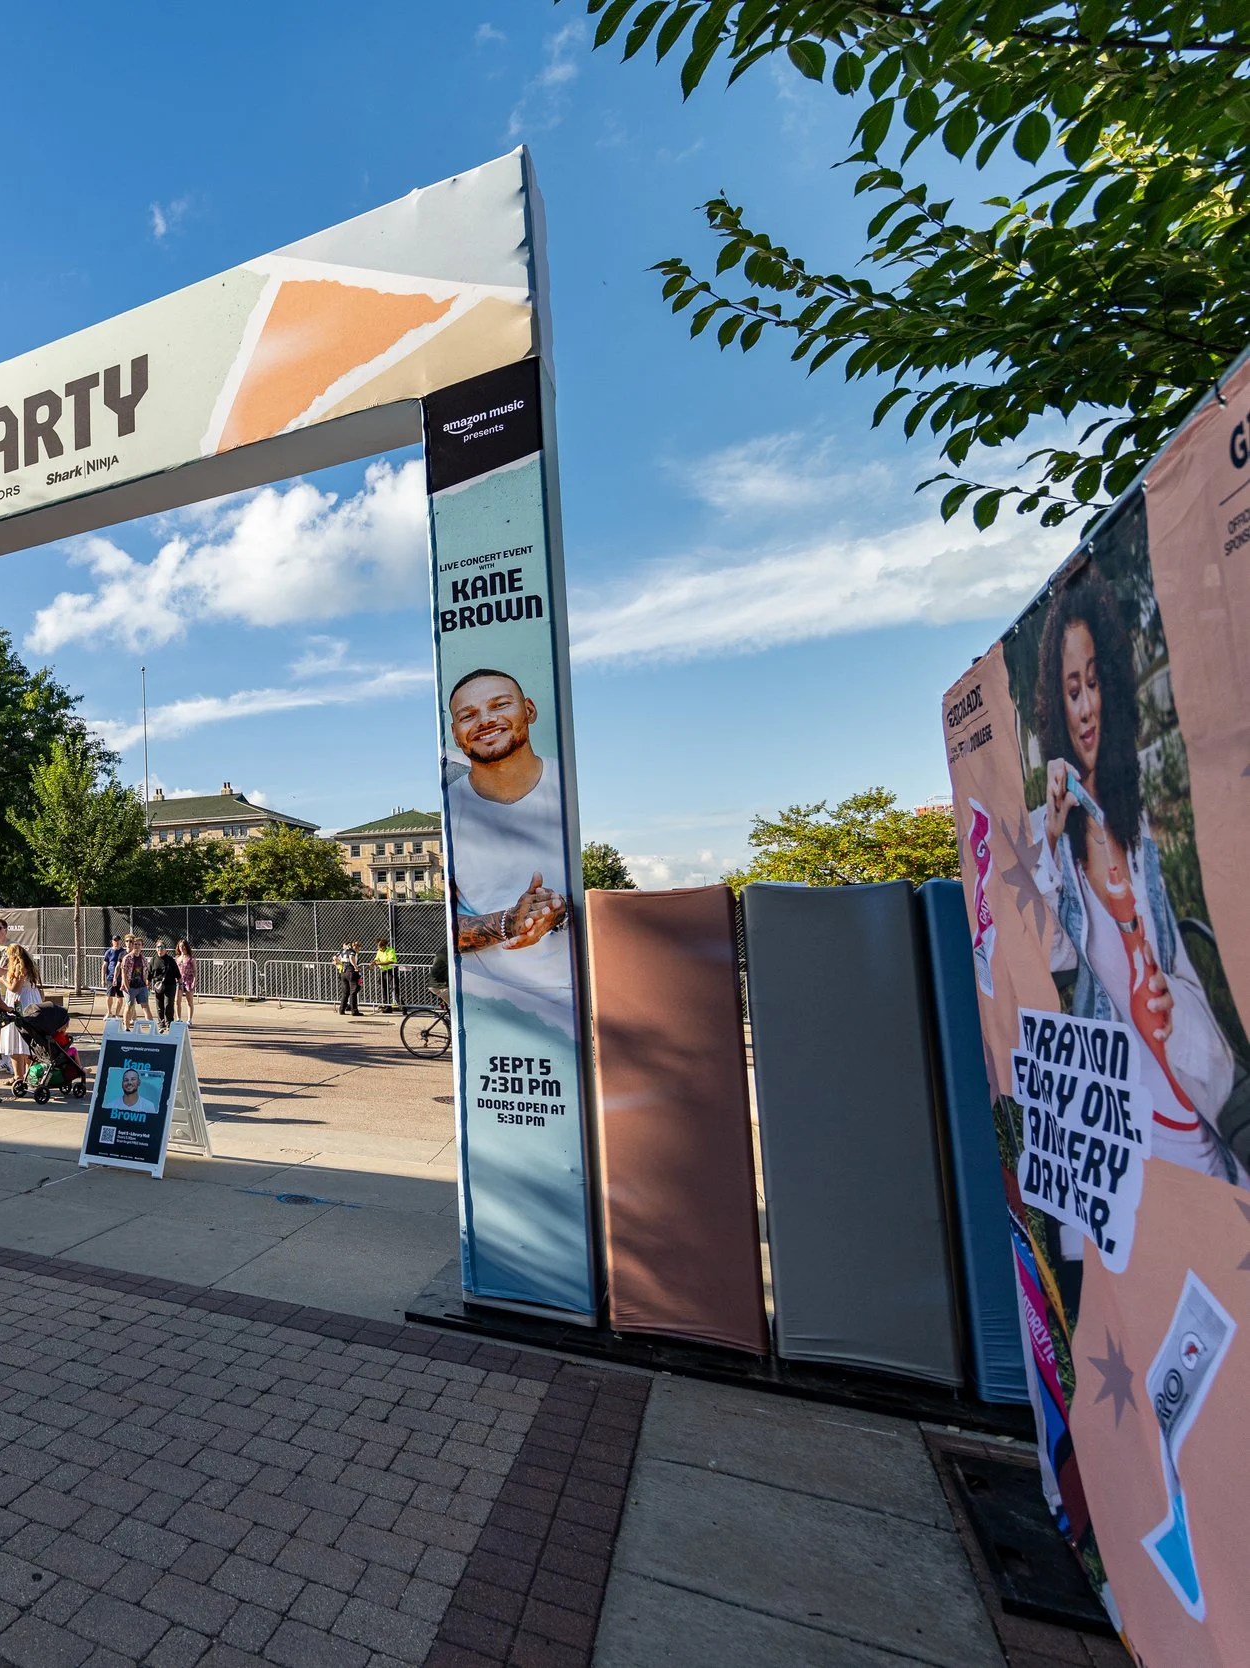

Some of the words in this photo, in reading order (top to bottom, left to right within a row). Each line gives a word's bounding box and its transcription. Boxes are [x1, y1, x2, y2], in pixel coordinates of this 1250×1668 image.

[442, 409, 487, 435] amazon
[488, 399, 525, 419] music
[463, 423, 504, 443] presents
[46, 464, 83, 486] Shark
[86, 454, 120, 475] NINJA
[439, 559, 459, 573] LIVE
[460, 552, 502, 568] CONCERT
[503, 545, 534, 560] EVENT
[478, 562, 495, 572] WITH
[451, 567, 524, 604] KANE
[440, 594, 544, 633] BROWN
[124, 1058, 151, 1071] Kane
[489, 1056, 534, 1074] SEPT
[539, 1058, 552, 1076] 5
[480, 1075, 523, 1095] 7:30
[528, 1078, 561, 1097] PM
[110, 1108, 147, 1122] Brown
[477, 1097, 515, 1111] DOORS
[517, 1101, 548, 1115] OPEN
[550, 1104, 566, 1116] AT
[1080, 1080, 1142, 1145] ONE.
[497, 1112, 523, 1125] 5:30
[525, 1115, 546, 1127] PM
